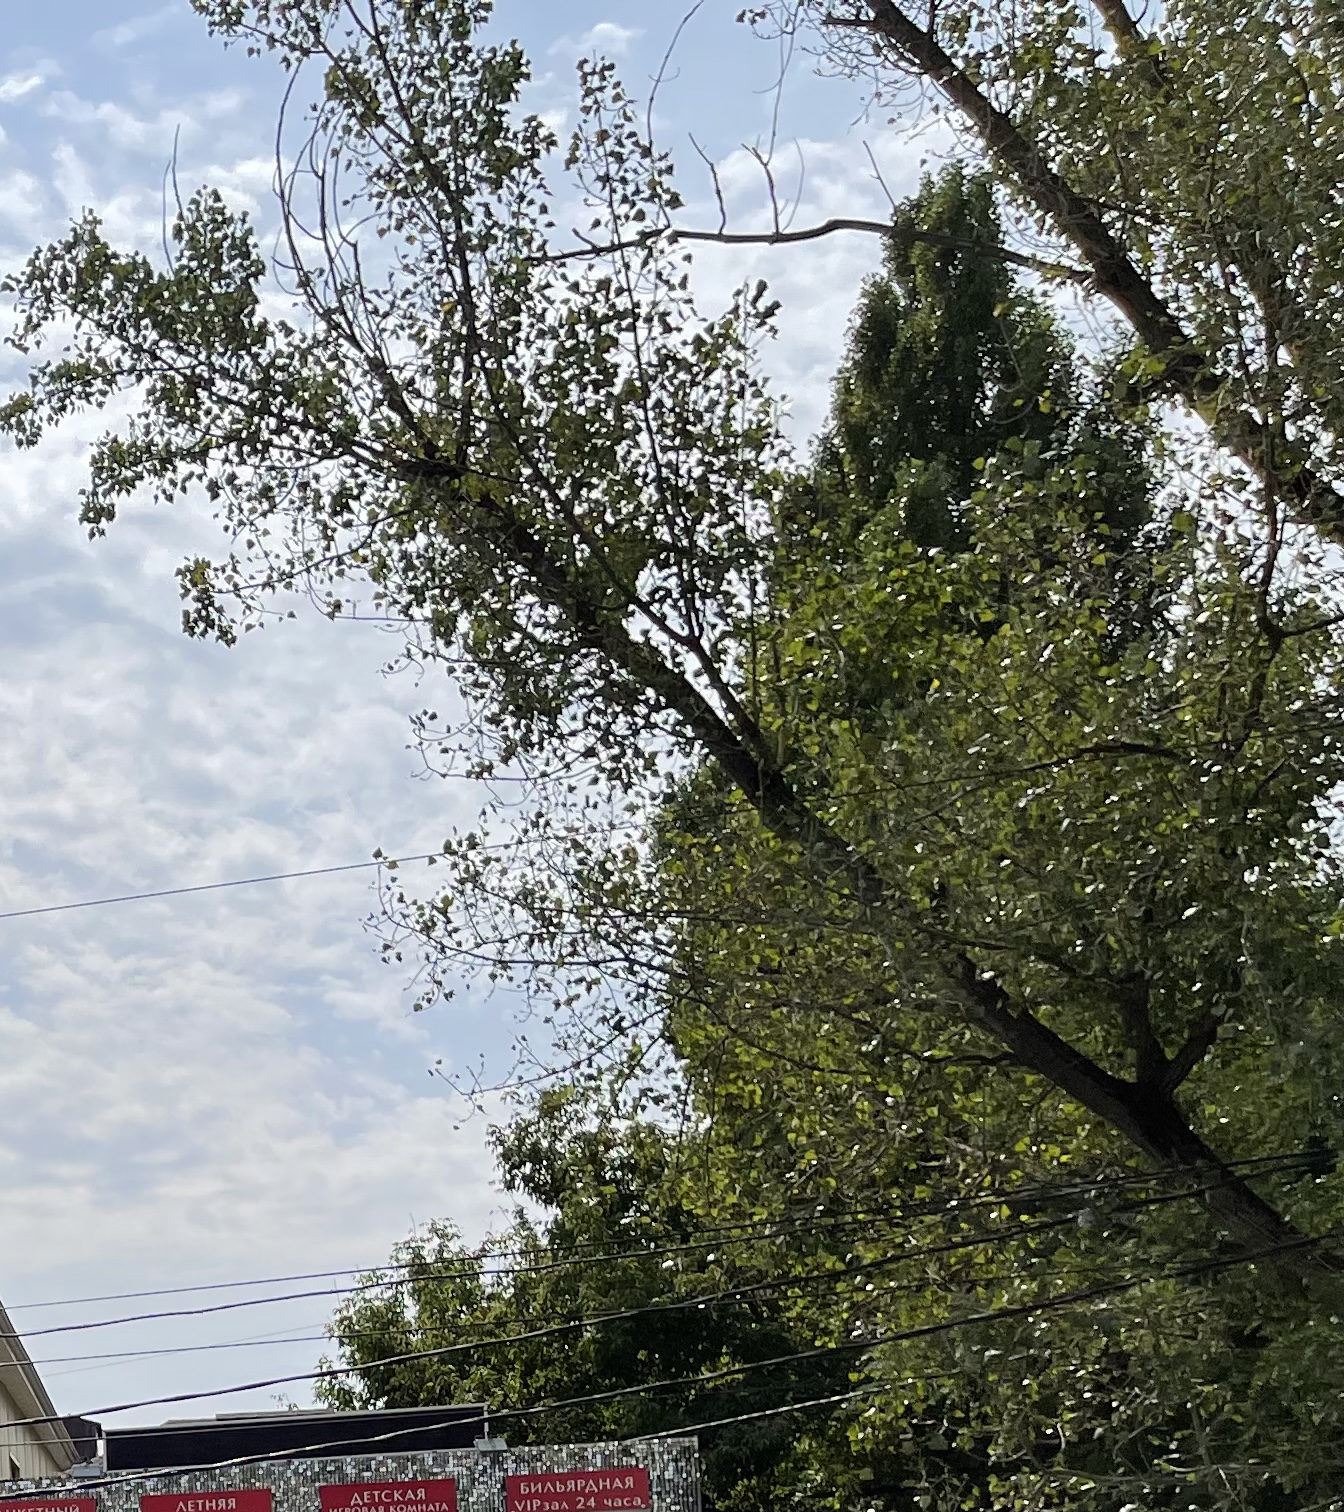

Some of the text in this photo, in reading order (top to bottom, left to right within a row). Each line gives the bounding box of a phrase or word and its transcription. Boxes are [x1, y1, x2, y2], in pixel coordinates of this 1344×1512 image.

[519, 1475, 634, 1495] БИЛЬЯРДНАЯ
[175, 1497, 237, 1512] ЛЕТНЯЯ
[350, 1488, 426, 1506] ДЕТСКАЯ
[575, 1497, 596, 1510] 24
[603, 1496, 642, 1508] часа
